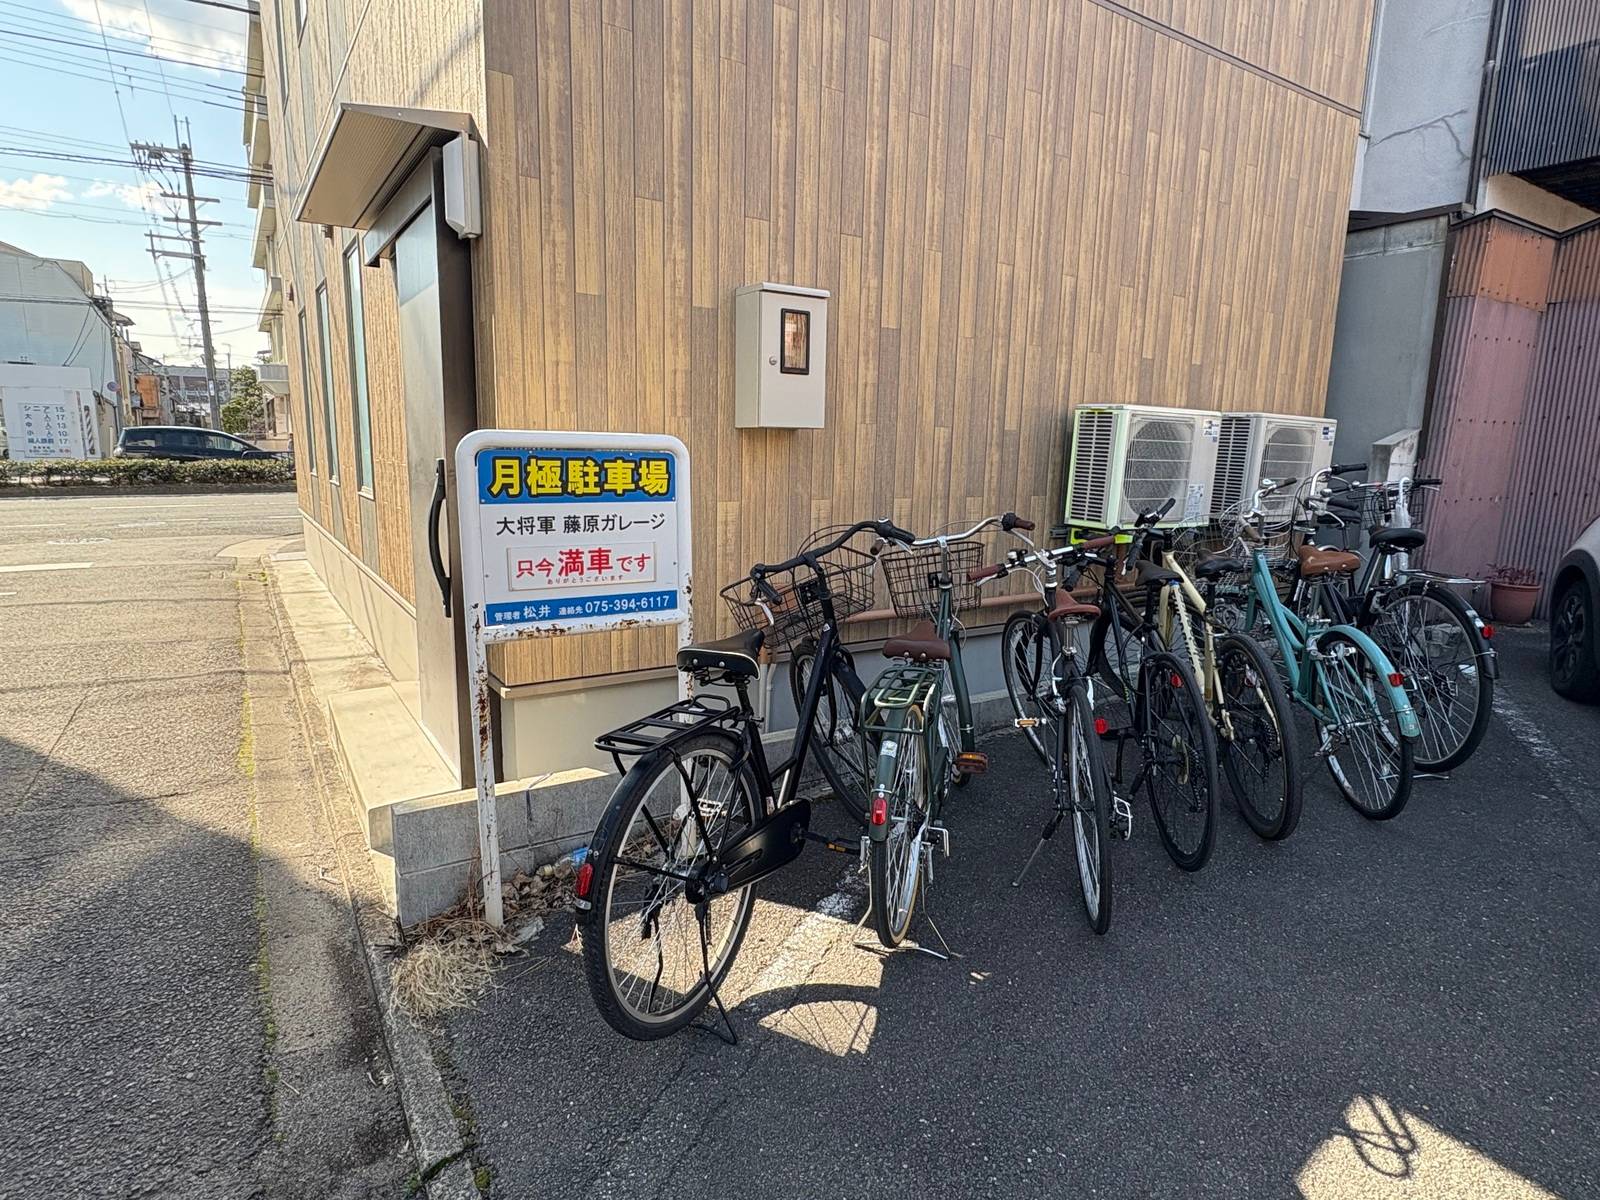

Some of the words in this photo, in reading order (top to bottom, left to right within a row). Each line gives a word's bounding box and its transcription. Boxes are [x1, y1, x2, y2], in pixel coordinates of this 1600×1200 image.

[489, 458, 671, 498] 月極駐車場
[496, 515, 556, 536] 大将軍
[563, 513, 665, 533] 藤原ガレージ
[516, 547, 651, 578] 只今満車です
[547, 575, 624, 585] ありがとうございます
[523, 604, 551, 619] 松井
[558, 606, 583, 616] 連絡先
[585, 595, 670, 614] 075-394-6117
